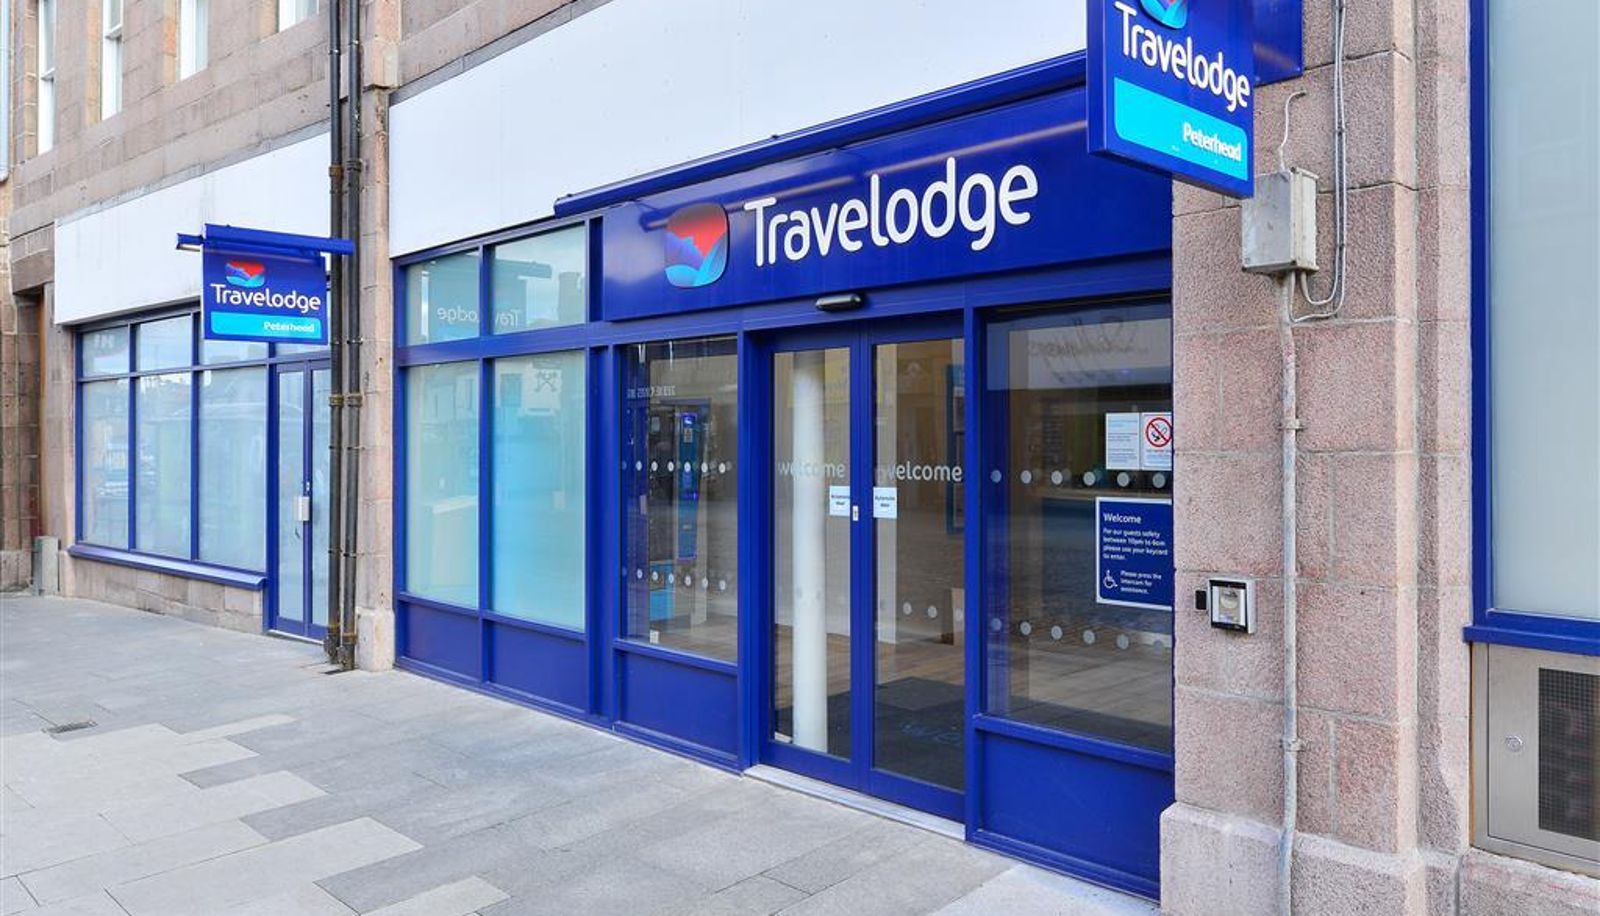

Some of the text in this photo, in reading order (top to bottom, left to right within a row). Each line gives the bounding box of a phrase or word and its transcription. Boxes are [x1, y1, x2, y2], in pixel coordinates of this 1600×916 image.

[1114, 1, 1250, 112] Travelodge
[1183, 121, 1241, 161] Peterhead
[744, 156, 1039, 267] Travelodge
[210, 282, 321, 314] Travelodge
[263, 321, 315, 333] Peterhead
[777, 460, 846, 478] welcome
[1103, 512, 1141, 524] Welcome
[1103, 536, 1127, 544] between
[1142, 530, 1160, 539] safety
[1132, 547, 1145, 555] your
[1146, 547, 1168, 556] keycard
